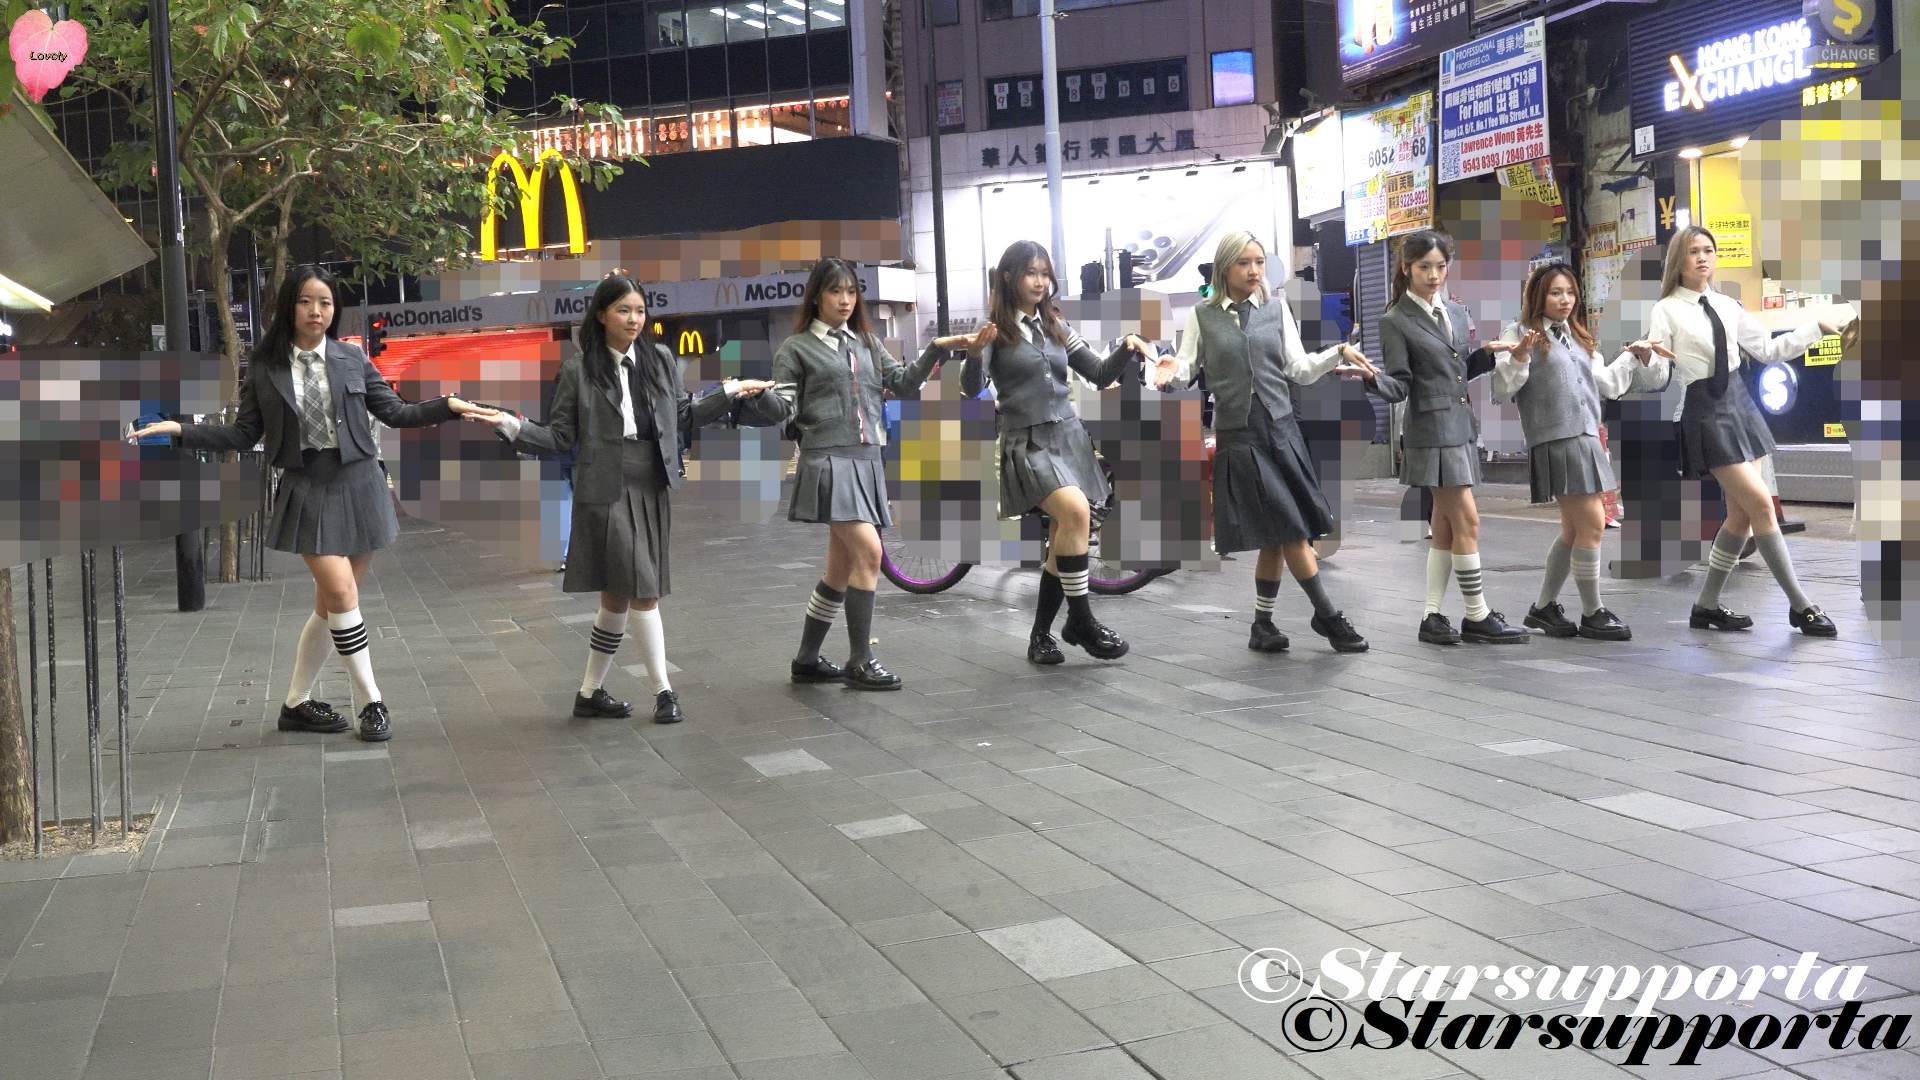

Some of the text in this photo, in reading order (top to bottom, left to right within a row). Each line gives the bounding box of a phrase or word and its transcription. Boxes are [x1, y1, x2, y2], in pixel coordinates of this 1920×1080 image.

[1456, 40, 1495, 60] PROFESSIONAL
[1698, 17, 1812, 69] HONG KONG
[1664, 50, 1812, 111] EXCHANGE
[1459, 104, 1471, 120] For
[1473, 97, 1493, 117] Rent
[1461, 122, 1543, 154] Lawrence Wong 黃先生
[1462, 157, 1481, 173] 9543
[1481, 153, 1500, 169] 8393
[1506, 146, 1525, 164] 2840
[1526, 142, 1544, 159] 1388
